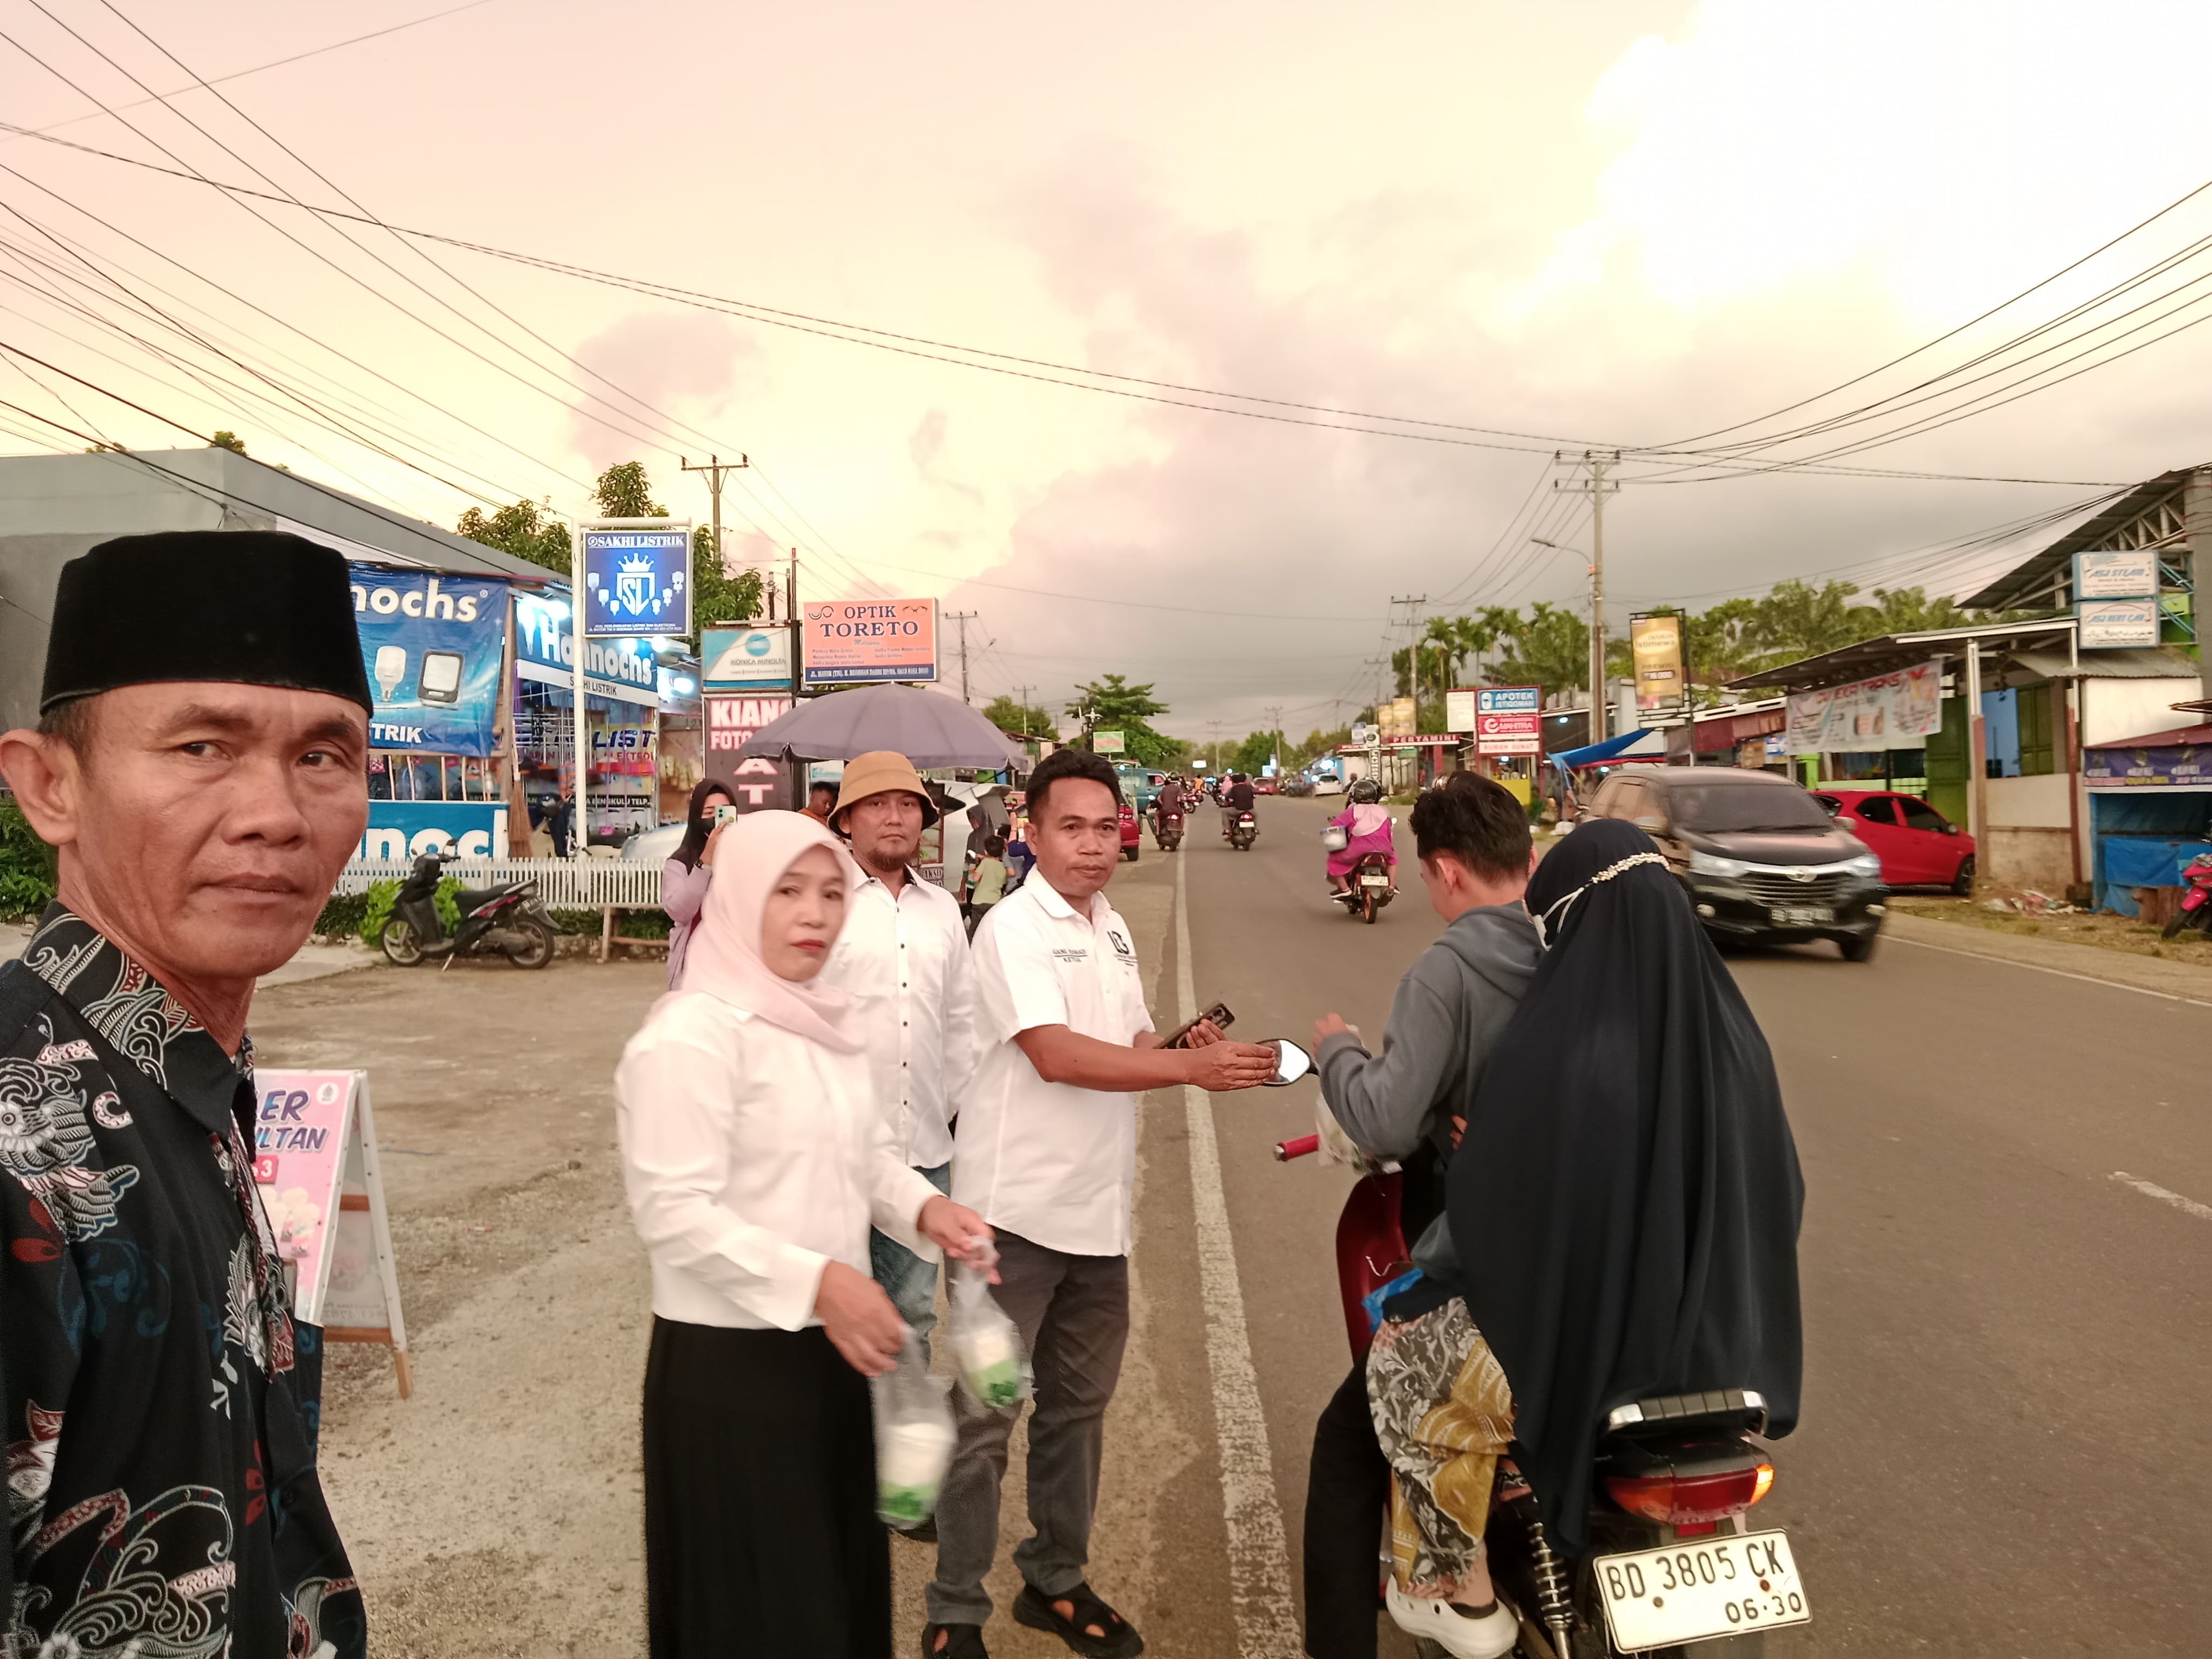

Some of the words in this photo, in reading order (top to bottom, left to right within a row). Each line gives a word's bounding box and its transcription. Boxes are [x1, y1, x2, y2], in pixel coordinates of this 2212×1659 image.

[598, 536, 634, 546] SAKHI
[636, 536, 685, 546] LISTRIK
[350, 578, 478, 622] nochs
[844, 606, 897, 619] OPTIK
[820, 621, 918, 638] TORETO
[570, 676, 590, 691] SHI
[591, 683, 618, 696] LISTRIK
[1495, 692, 1534, 701] APOTEK
[370, 723, 423, 744] TRIK
[593, 730, 656, 750] LIST
[1393, 735, 1457, 743] PERTAMINI
[1605, 1562, 1645, 1601] BD
[1656, 1546, 1737, 1590] 3805
[1746, 1539, 1784, 1578] CK
